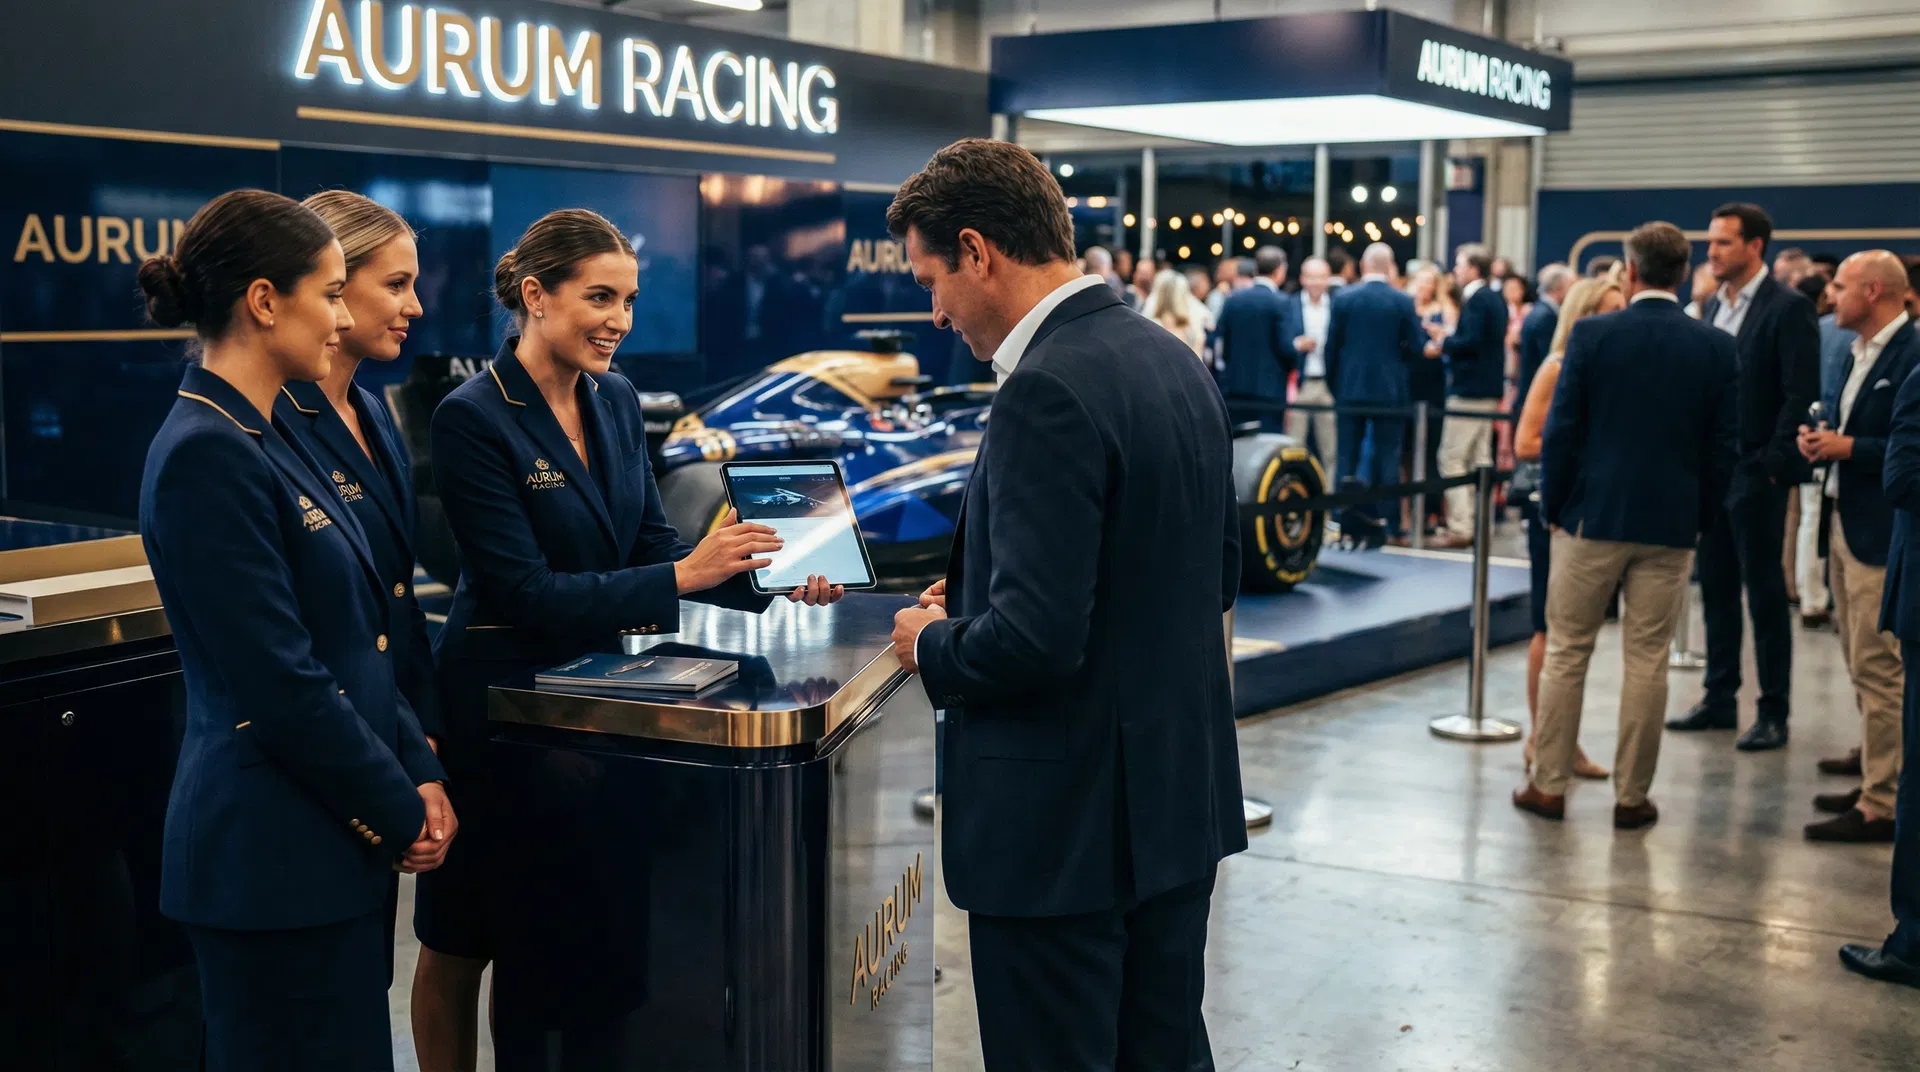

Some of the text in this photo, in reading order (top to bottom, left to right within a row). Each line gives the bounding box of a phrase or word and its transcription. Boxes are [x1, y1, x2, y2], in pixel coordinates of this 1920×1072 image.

[294, 0, 838, 134] AURUM RACING
[1417, 39, 1551, 111] AURUM RACING
[344, 494, 364, 503] CING
[526, 471, 565, 485] AURUM
[532, 481, 565, 490] RACING
[850, 851, 923, 1006] AURUM
[870, 941, 908, 1011] RACING
